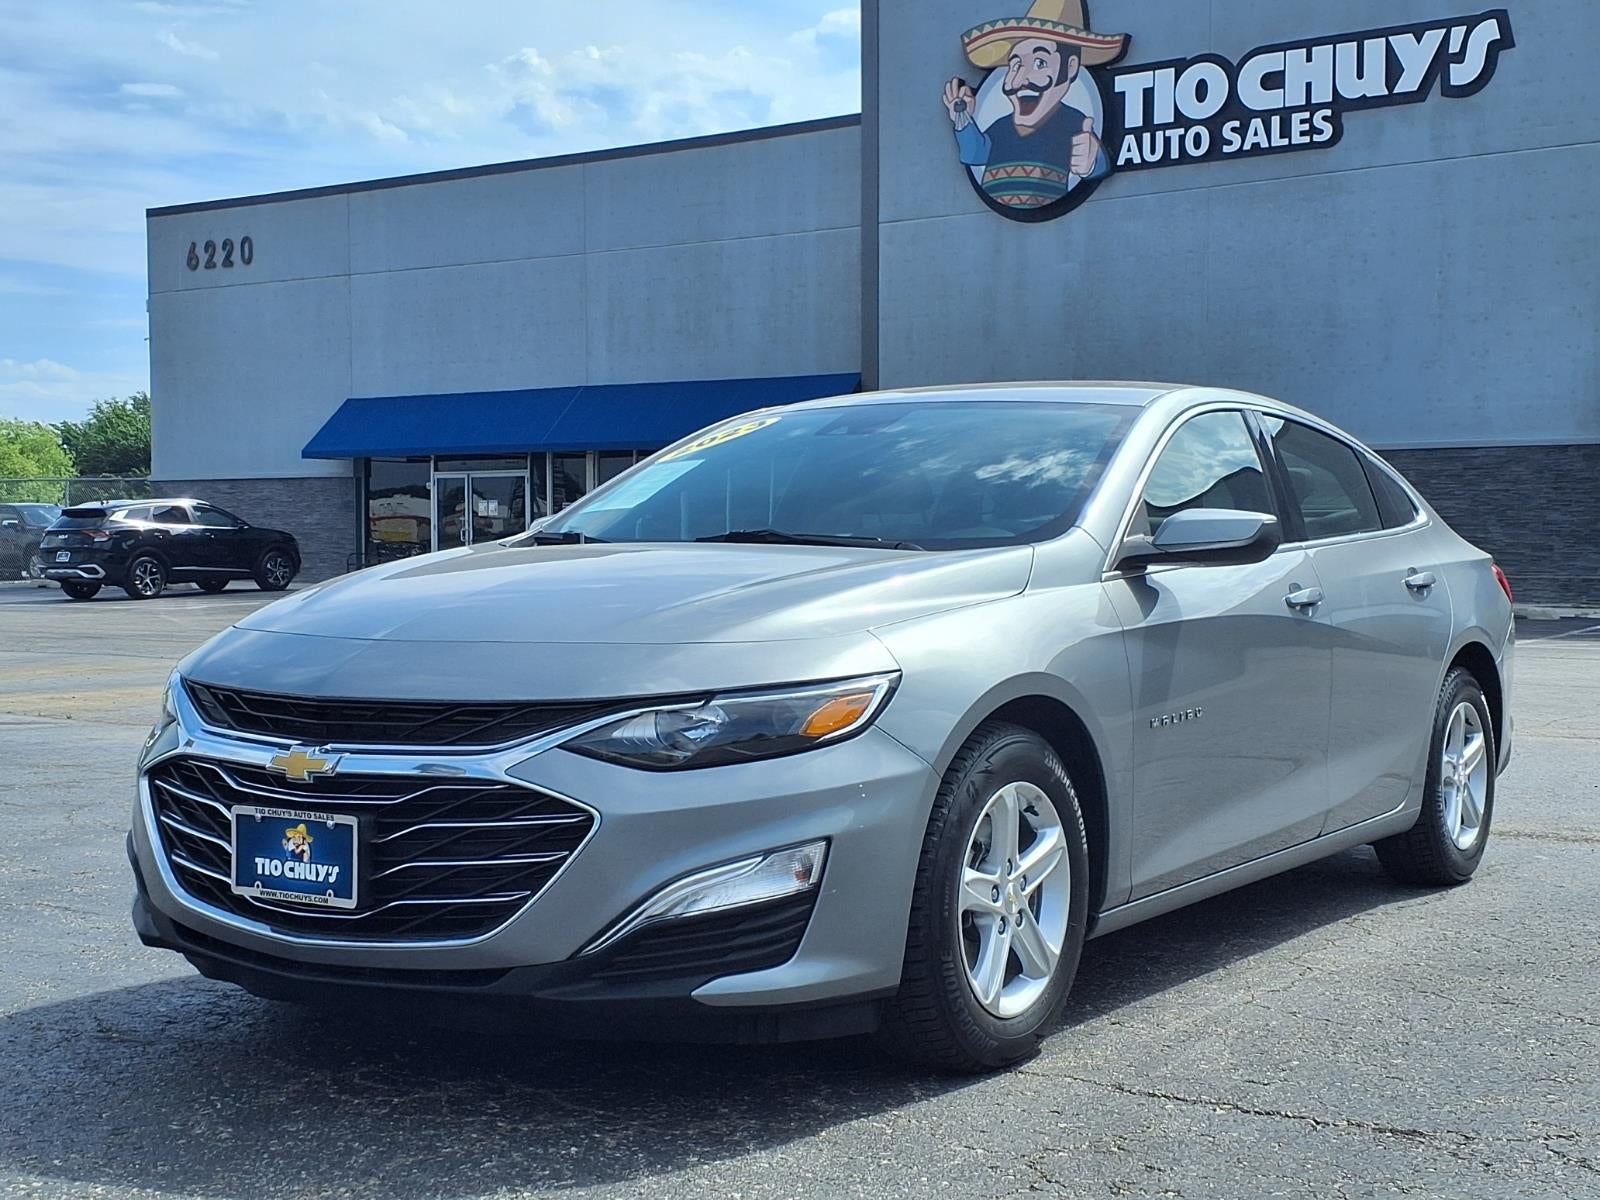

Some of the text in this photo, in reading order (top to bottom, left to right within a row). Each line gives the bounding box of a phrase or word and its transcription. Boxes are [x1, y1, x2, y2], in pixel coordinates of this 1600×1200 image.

[1114, 18, 1501, 129] TIO CHUY'S
[1116, 109, 1334, 167] AUTO SALES
[186, 235, 254, 272] 6220
[1149, 706, 1203, 729] MALIBU
[254, 807, 335, 821] TIO CHUY'S AUTO SALES
[254, 857, 340, 884] TIO CHUY'S
[259, 890, 329, 904] WWW.TIOCHUYS.COM
